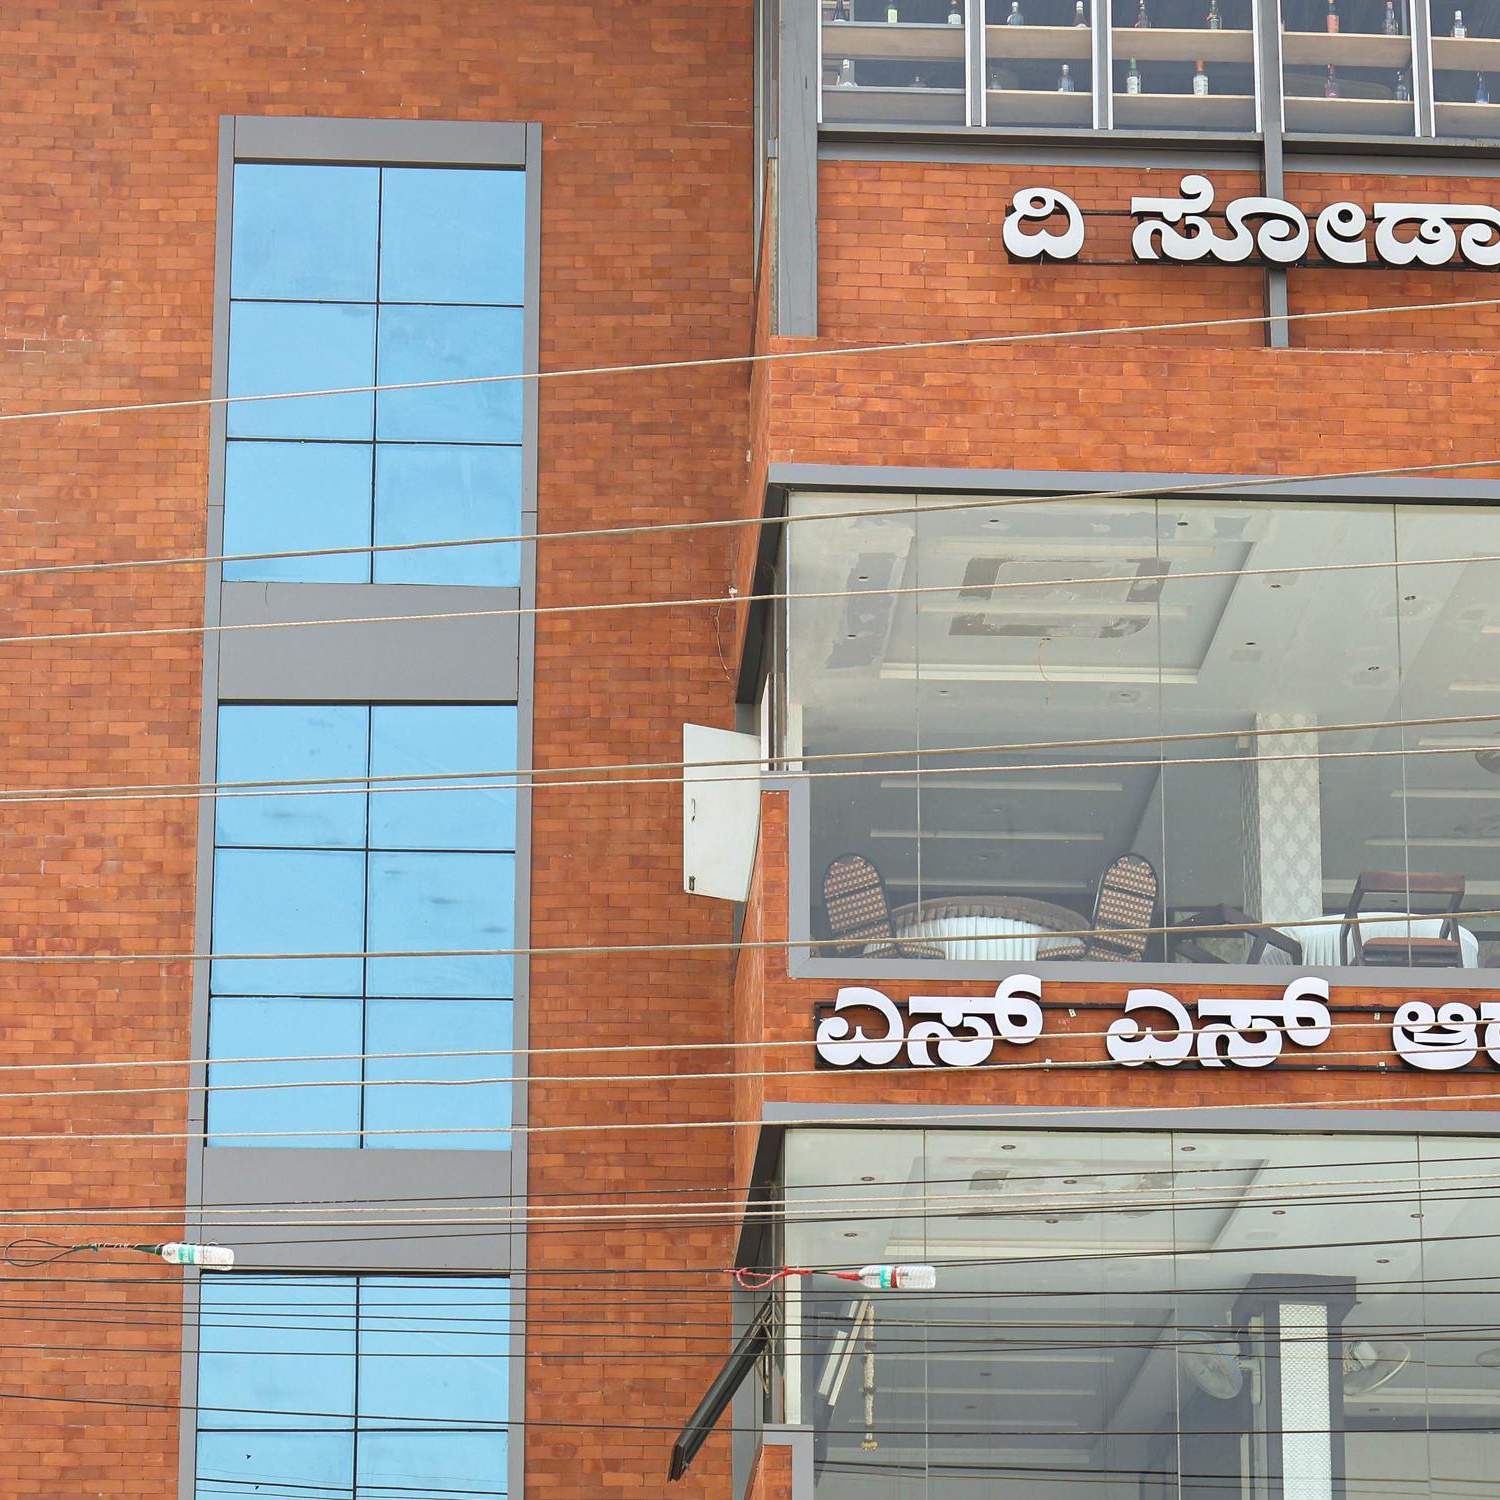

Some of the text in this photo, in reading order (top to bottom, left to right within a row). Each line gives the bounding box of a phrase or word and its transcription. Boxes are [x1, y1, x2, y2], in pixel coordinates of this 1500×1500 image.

[1002, 186, 1085, 259] ದಿ
[815, 974, 1044, 1067] ಎಸ್
[1106, 976, 1331, 1068] ಎಸ್
